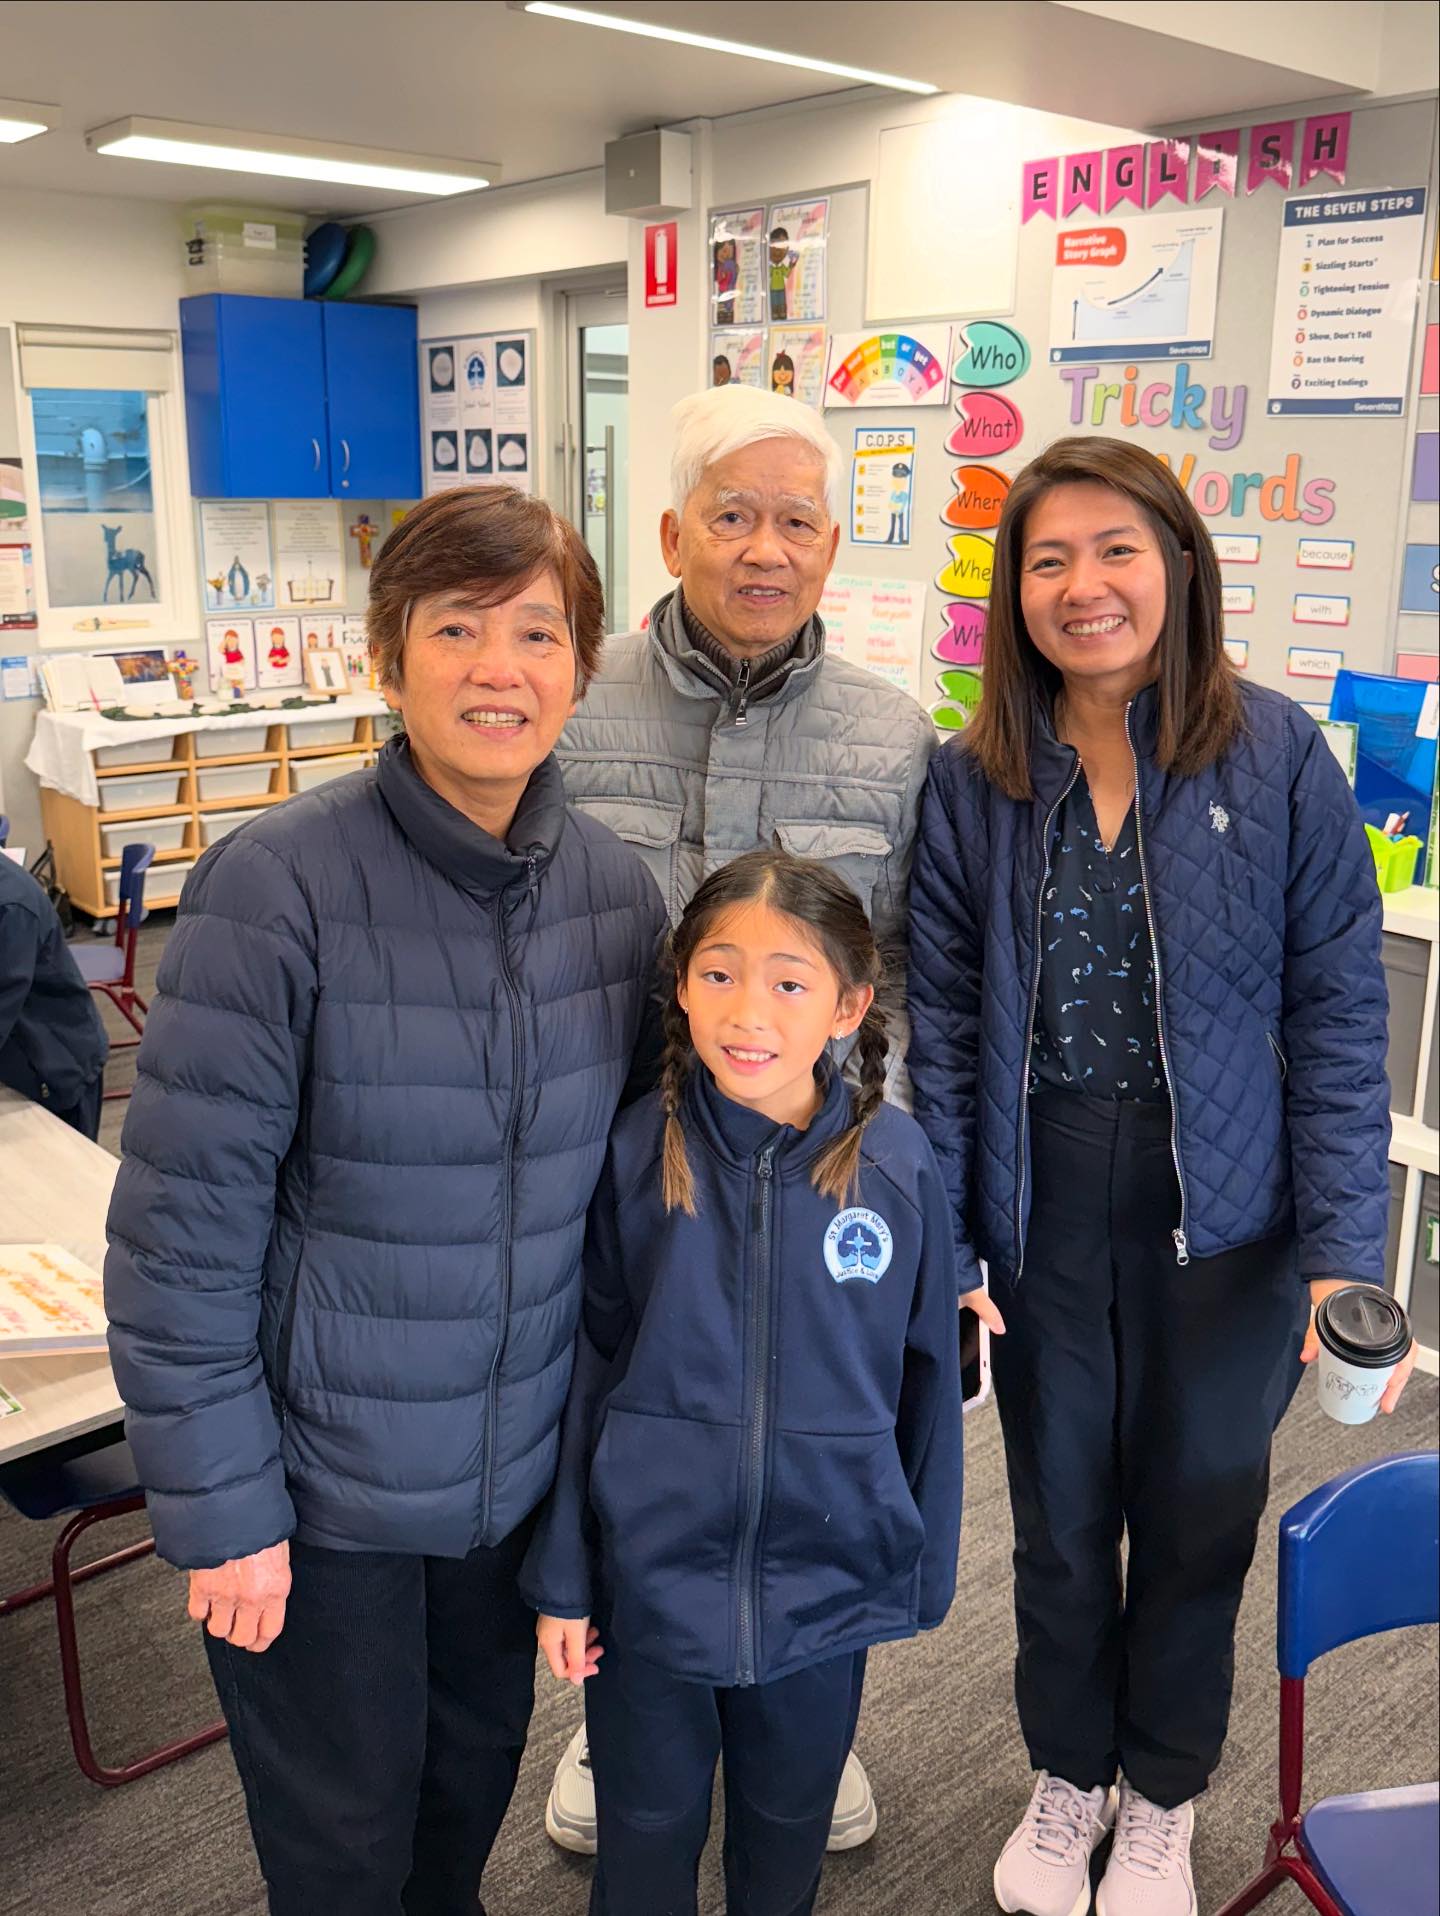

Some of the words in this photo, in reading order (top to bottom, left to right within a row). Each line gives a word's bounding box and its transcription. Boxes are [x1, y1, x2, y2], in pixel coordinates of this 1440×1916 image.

[1032, 127, 1339, 200] ENGLISH
[1295, 205, 1320, 219] THE
[1324, 200, 1366, 216] SEVEN
[1370, 195, 1415, 212] STEPS
[1317, 238, 1336, 247] Plan
[1337, 236, 1349, 246] for
[1351, 234, 1384, 244] Success
[1315, 260, 1347, 271] Sizzling
[1313, 282, 1356, 295] Tightening
[1357, 281, 1390, 292] Tension
[1310, 307, 1344, 319] Dynamic
[1345, 306, 1383, 318] Dialogue
[970, 344, 1017, 371] Who
[1306, 355, 1322, 364] Ban
[1323, 355, 1337, 364] the
[1337, 355, 1364, 365] Boring
[1304, 378, 1336, 388] Exciting
[1337, 378, 1368, 389] Endings
[1059, 363, 1248, 451] Tricky
[962, 416, 1014, 440] What
[1224, 544, 1242, 555] yes
[1302, 548, 1348, 562] because
[953, 558, 993, 582] Whe
[1310, 604, 1333, 615] with
[953, 625, 984, 648] Wh
[1298, 658, 1331, 670] which
[828, 1230, 838, 1241] St
[834, 1211, 869, 1230] Margaret
